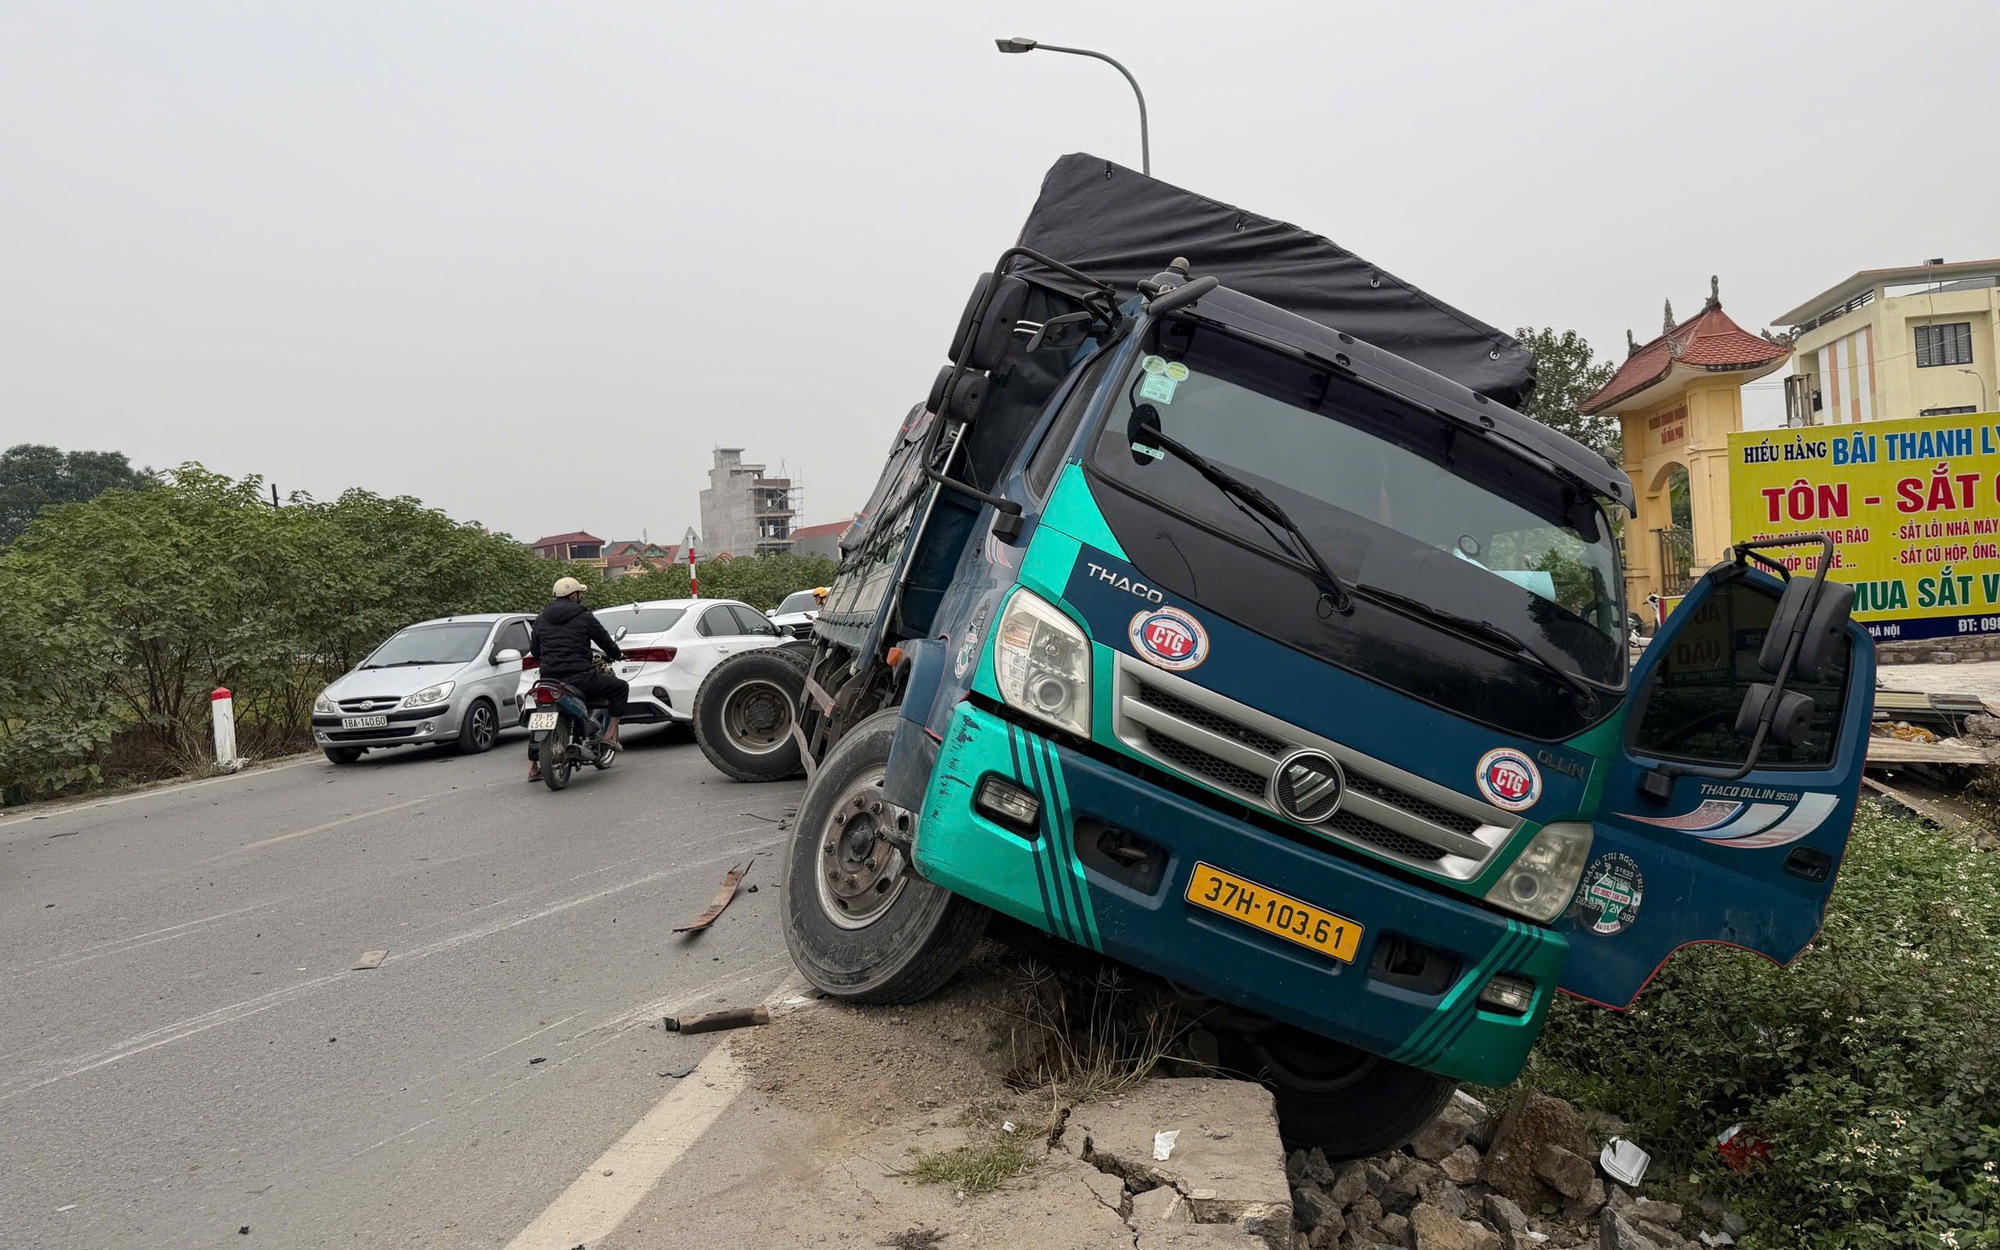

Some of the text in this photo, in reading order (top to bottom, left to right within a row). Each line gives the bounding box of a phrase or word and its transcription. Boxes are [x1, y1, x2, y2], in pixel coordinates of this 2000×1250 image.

[1744, 438, 1779, 463] HIẾU
[1784, 434, 1827, 460] HẰNG
[1832, 431, 1876, 465] BÃI
[1884, 428, 1972, 461] THANH
[1762, 479, 1848, 522] TÔN
[1896, 463, 1980, 513] SẮT
[1846, 526, 1869, 543] RÀO
[1900, 520, 1921, 539] SẮT
[1946, 518, 1970, 536] NHÀ
[1974, 516, 1999, 534] MÁY
[1901, 544, 1922, 564] SẮT
[1087, 562, 1163, 604] THACO
[1844, 580, 1908, 612] MUA
[1918, 565, 1973, 608] SẮT
[1869, 624, 1881, 636] HÀ
[1884, 624, 1900, 638] NỘI
[1958, 619, 1977, 632] ĐT:
[1700, 784, 1798, 801] THACO OLLIN 950A
[1204, 876, 1345, 950] 37H-103.61
